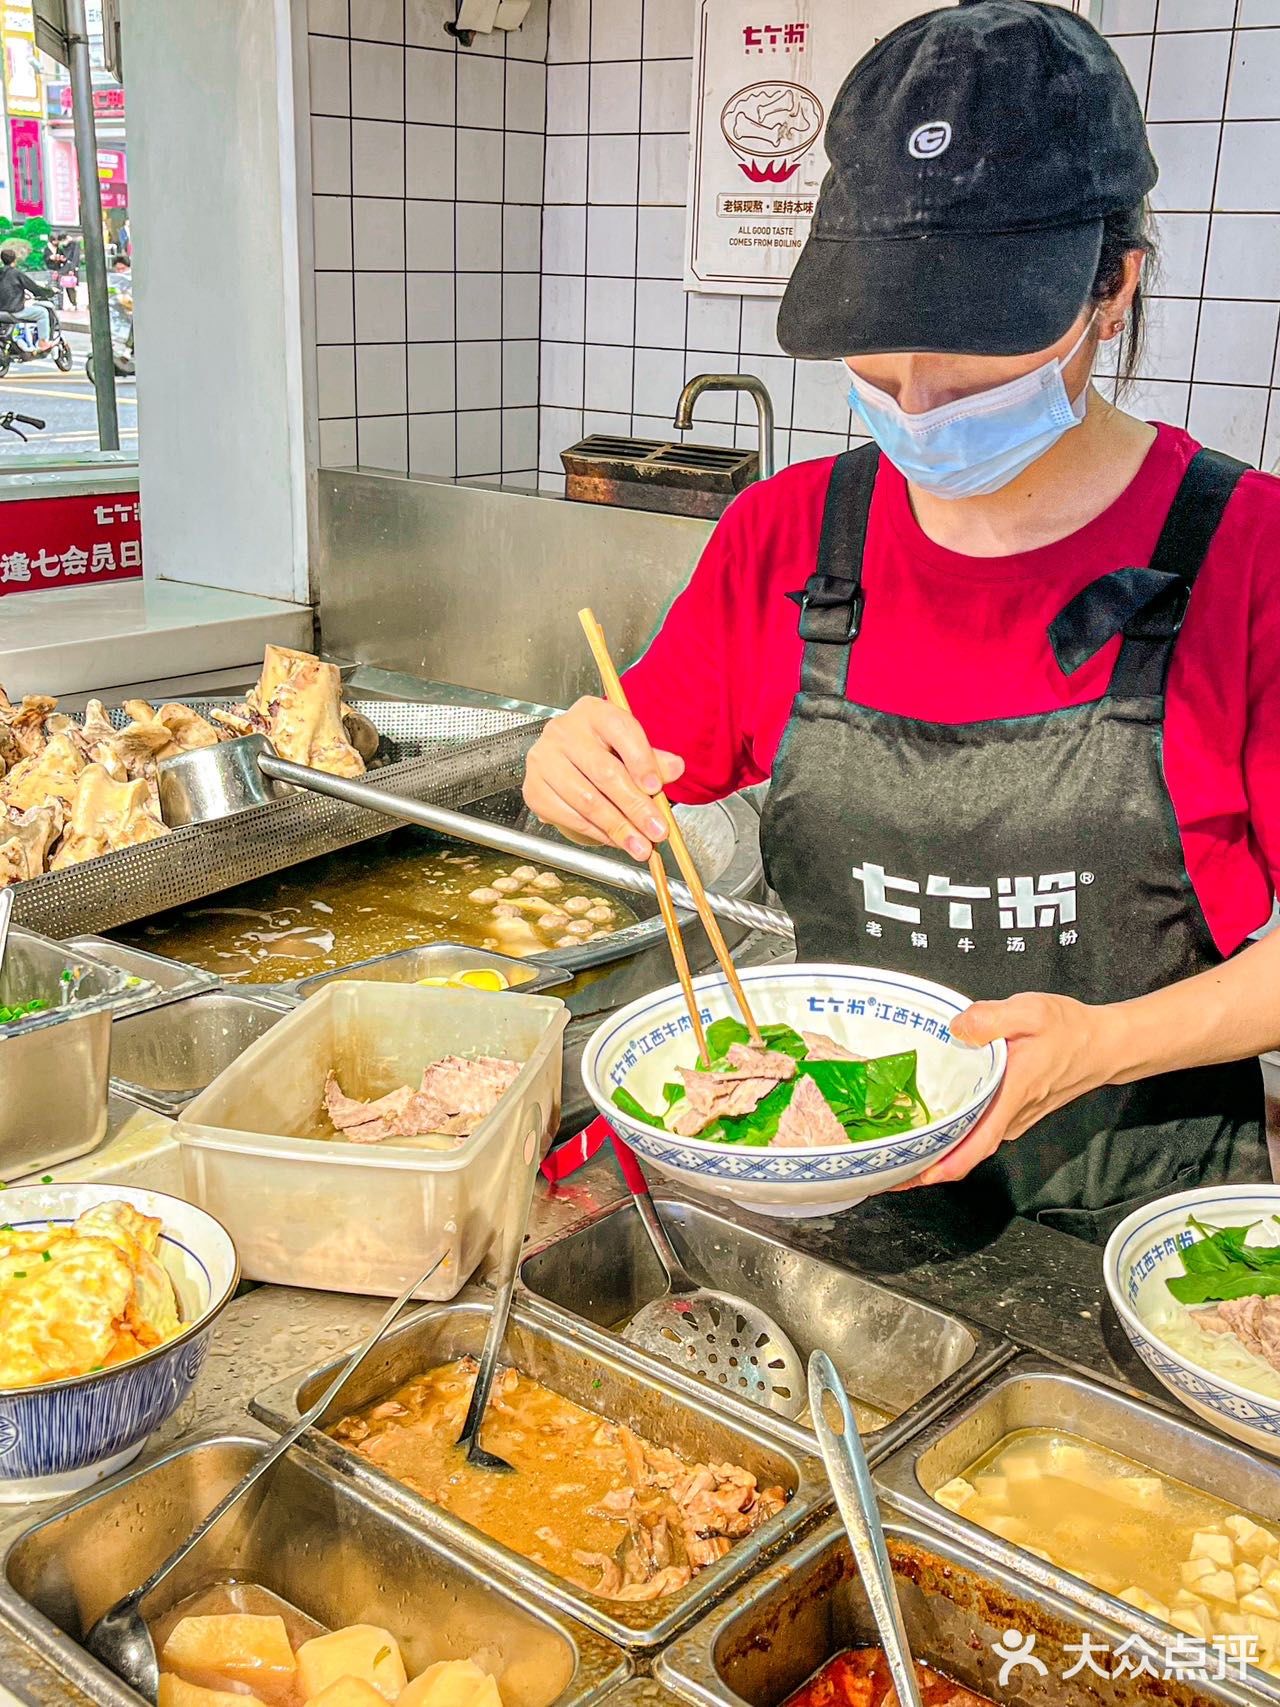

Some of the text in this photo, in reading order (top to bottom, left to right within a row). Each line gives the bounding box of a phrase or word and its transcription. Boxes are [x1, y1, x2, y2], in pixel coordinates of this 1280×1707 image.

[738, 226, 794, 236] ALL GOOD TASTE
[729, 238, 802, 248] COMES FROM BOILING
[0, 540, 142, 583] 逢七会员日
